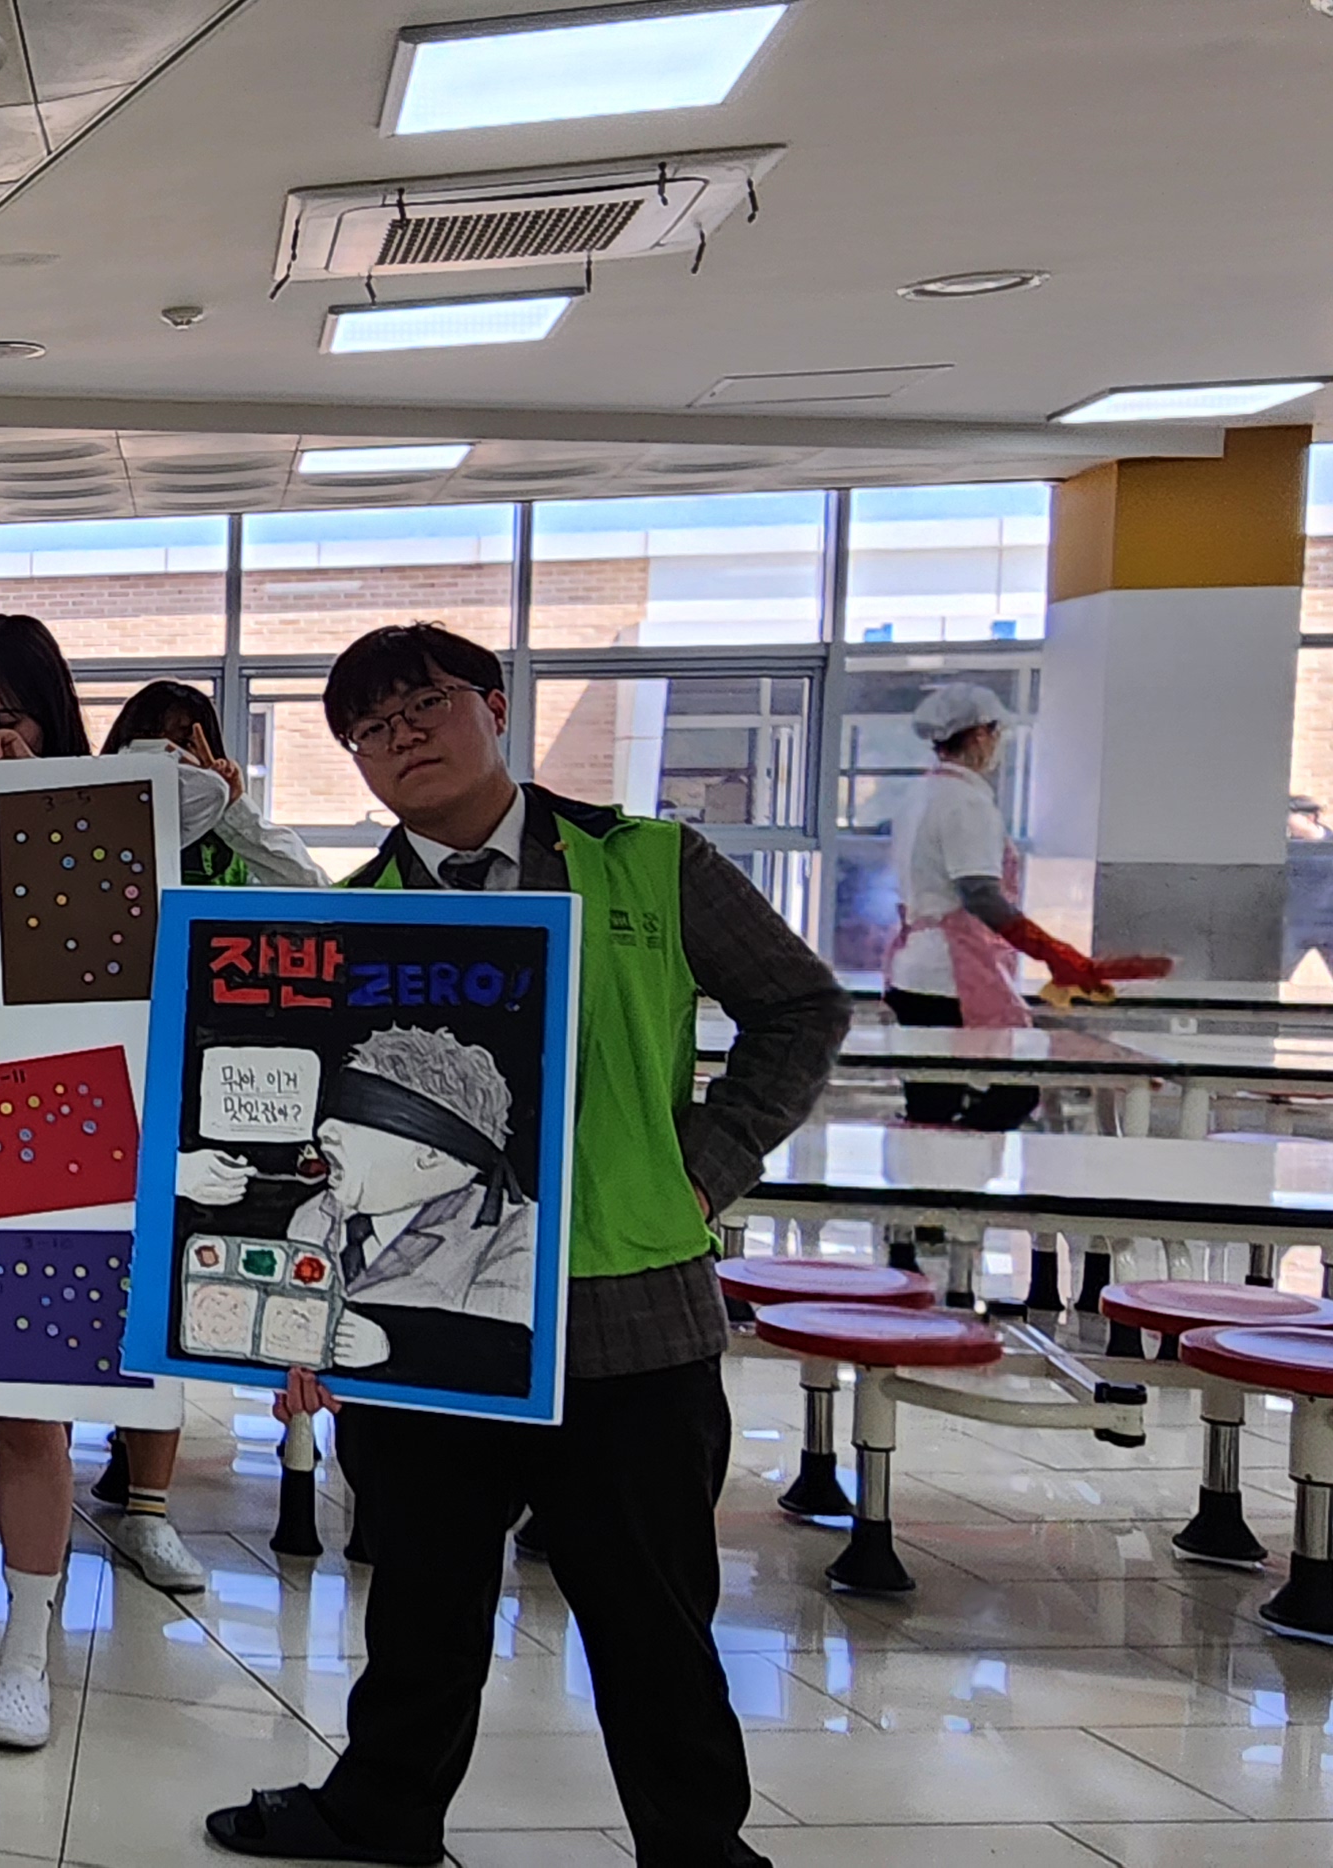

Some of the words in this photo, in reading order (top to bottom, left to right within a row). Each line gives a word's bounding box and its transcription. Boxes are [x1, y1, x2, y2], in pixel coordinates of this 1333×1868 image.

[209, 935, 344, 1008] 잔반
[347, 961, 532, 1012] ZERO!
[266, 1068, 298, 1094] 이거
